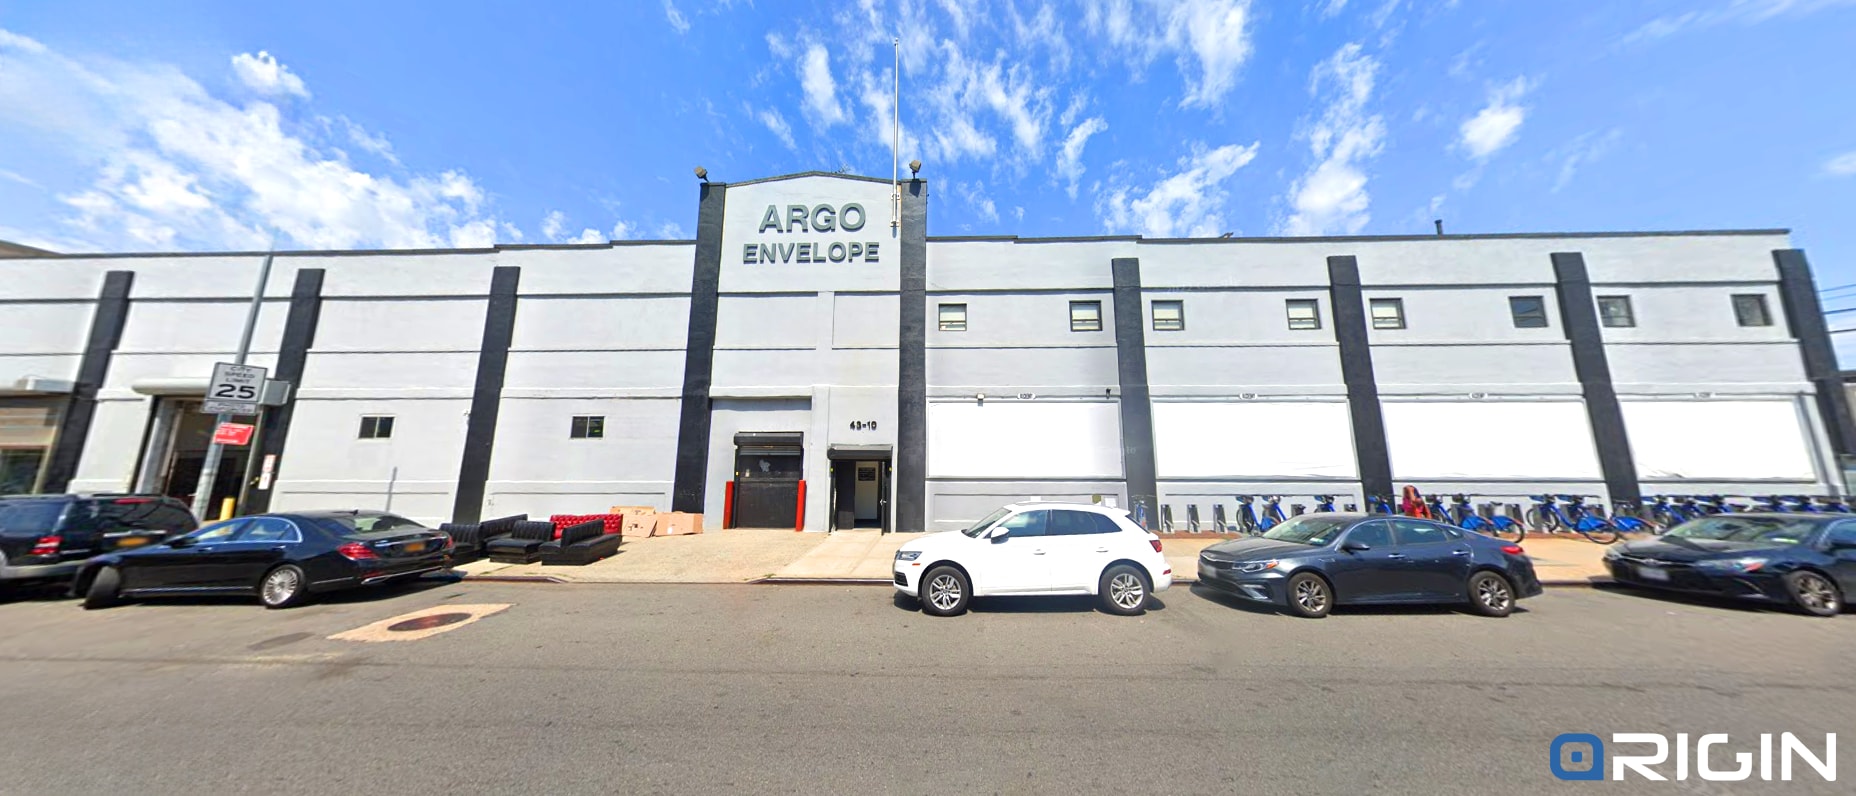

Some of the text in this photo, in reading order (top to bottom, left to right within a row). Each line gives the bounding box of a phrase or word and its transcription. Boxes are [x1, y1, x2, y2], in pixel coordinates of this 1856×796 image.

[759, 203, 866, 233] ARGO
[743, 241, 880, 264] ENVELOPE
[215, 383, 256, 399] 25
